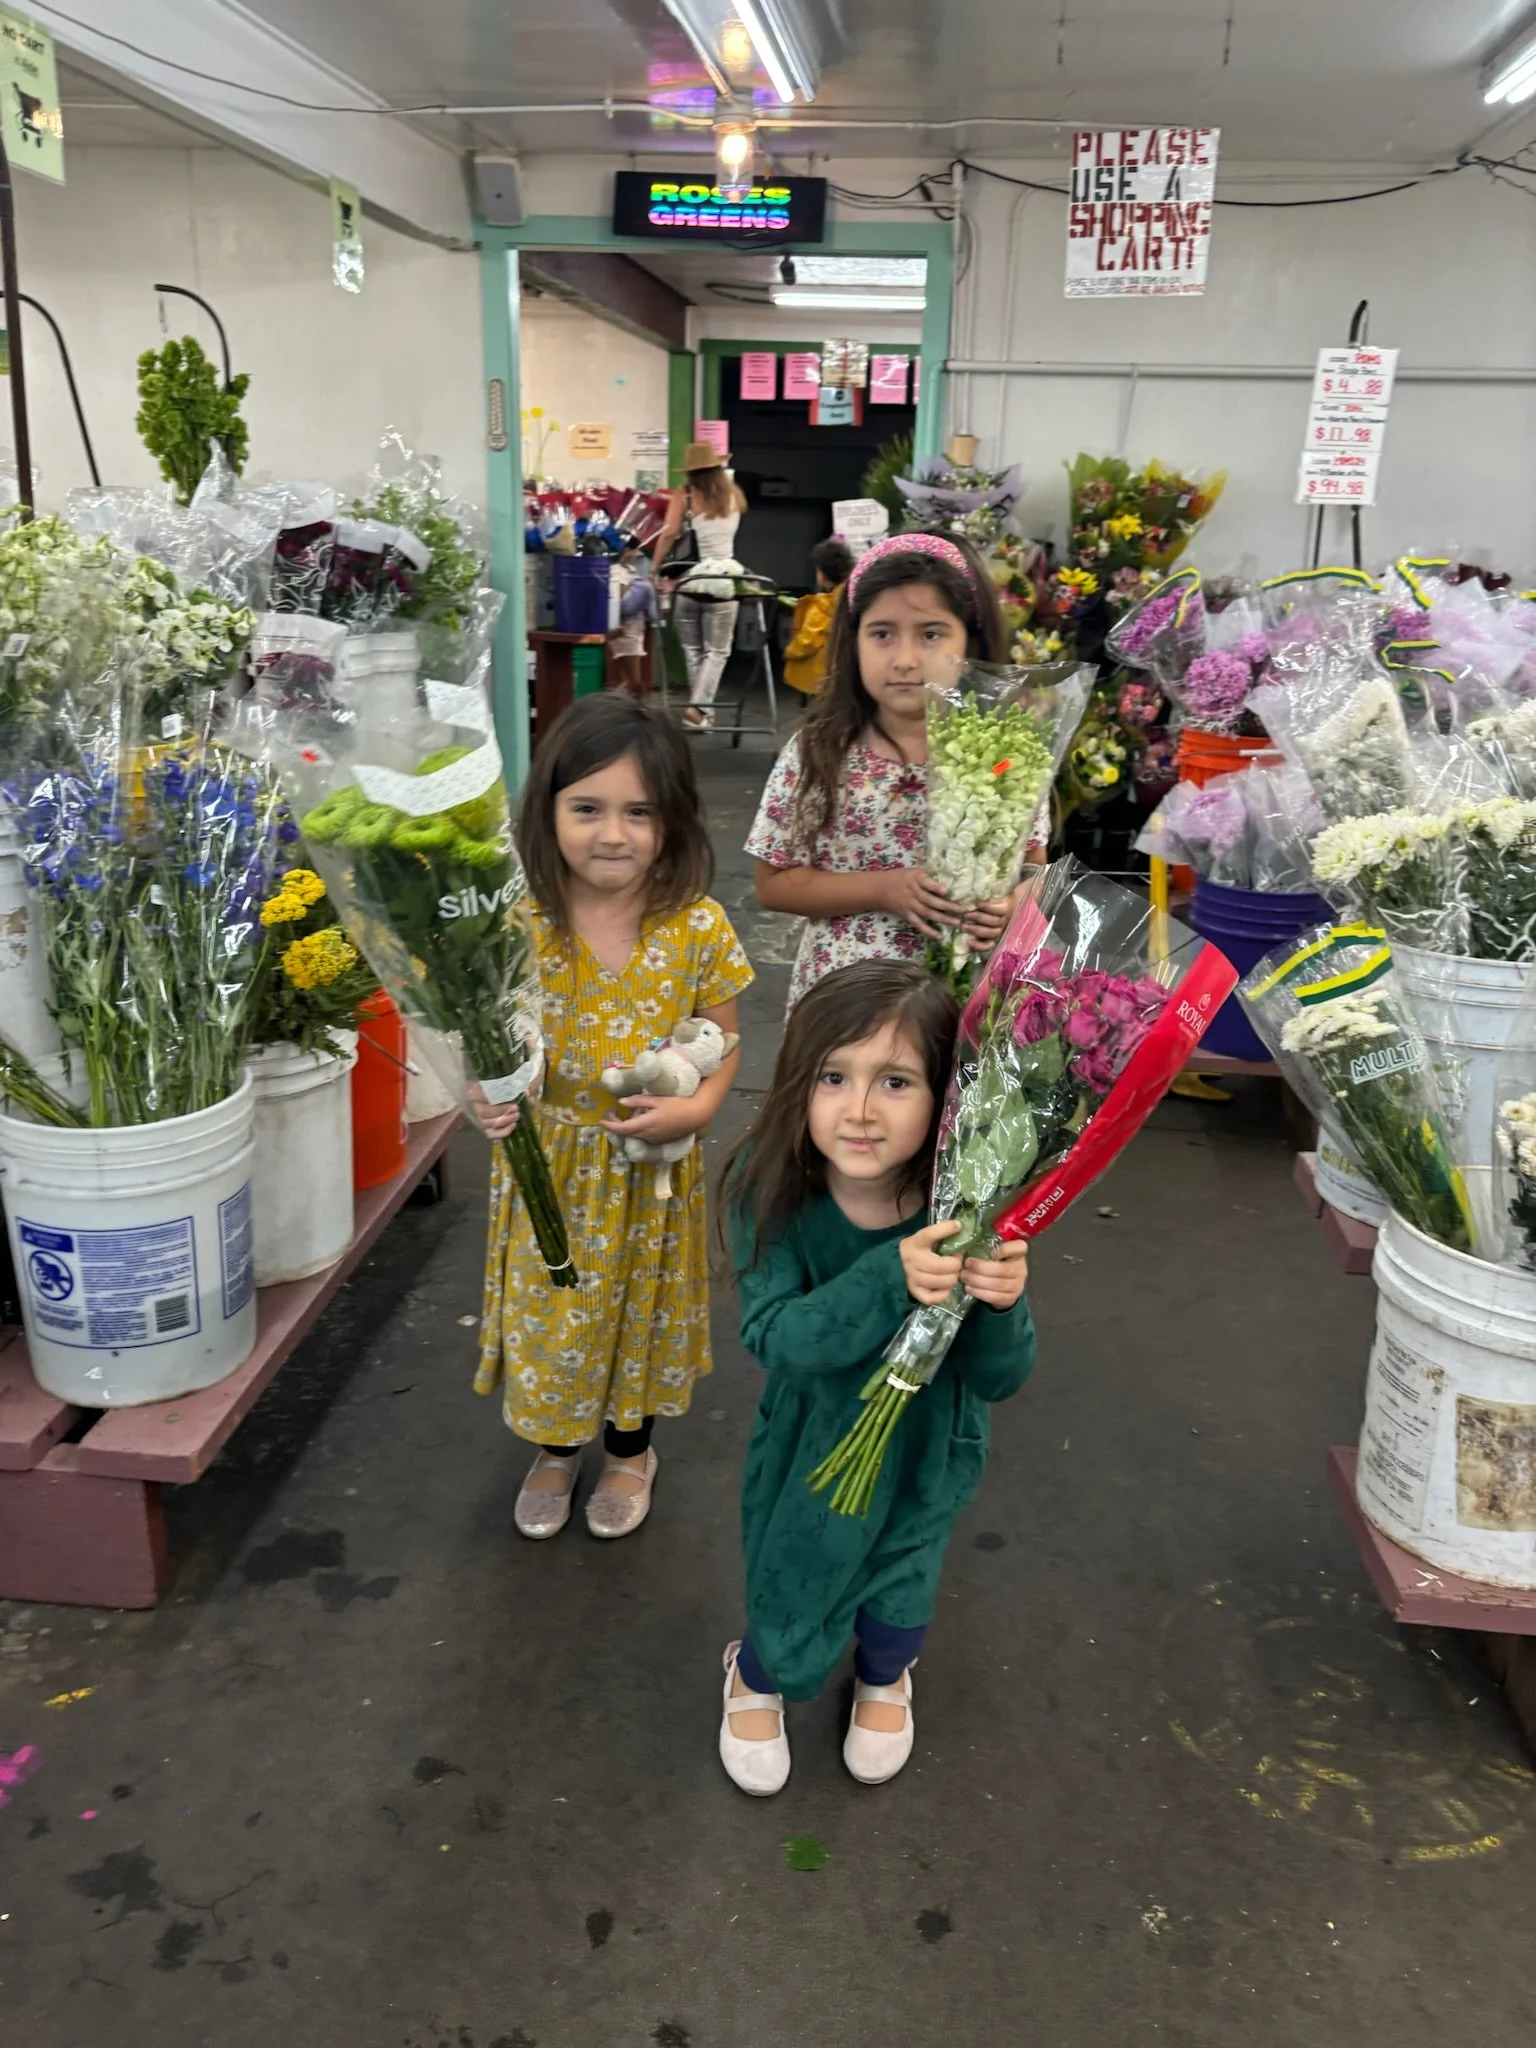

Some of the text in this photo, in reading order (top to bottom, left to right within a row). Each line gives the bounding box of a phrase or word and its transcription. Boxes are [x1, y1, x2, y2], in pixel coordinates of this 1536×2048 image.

[1072, 128, 1212, 167] PLEASE
[1071, 166, 1182, 203] USE A
[648, 206, 790, 229] GREENS
[1069, 201, 1213, 238] SHOPPING
[1096, 236, 1195, 271] CART!
[1176, 1000, 1207, 1036] ROYAL
